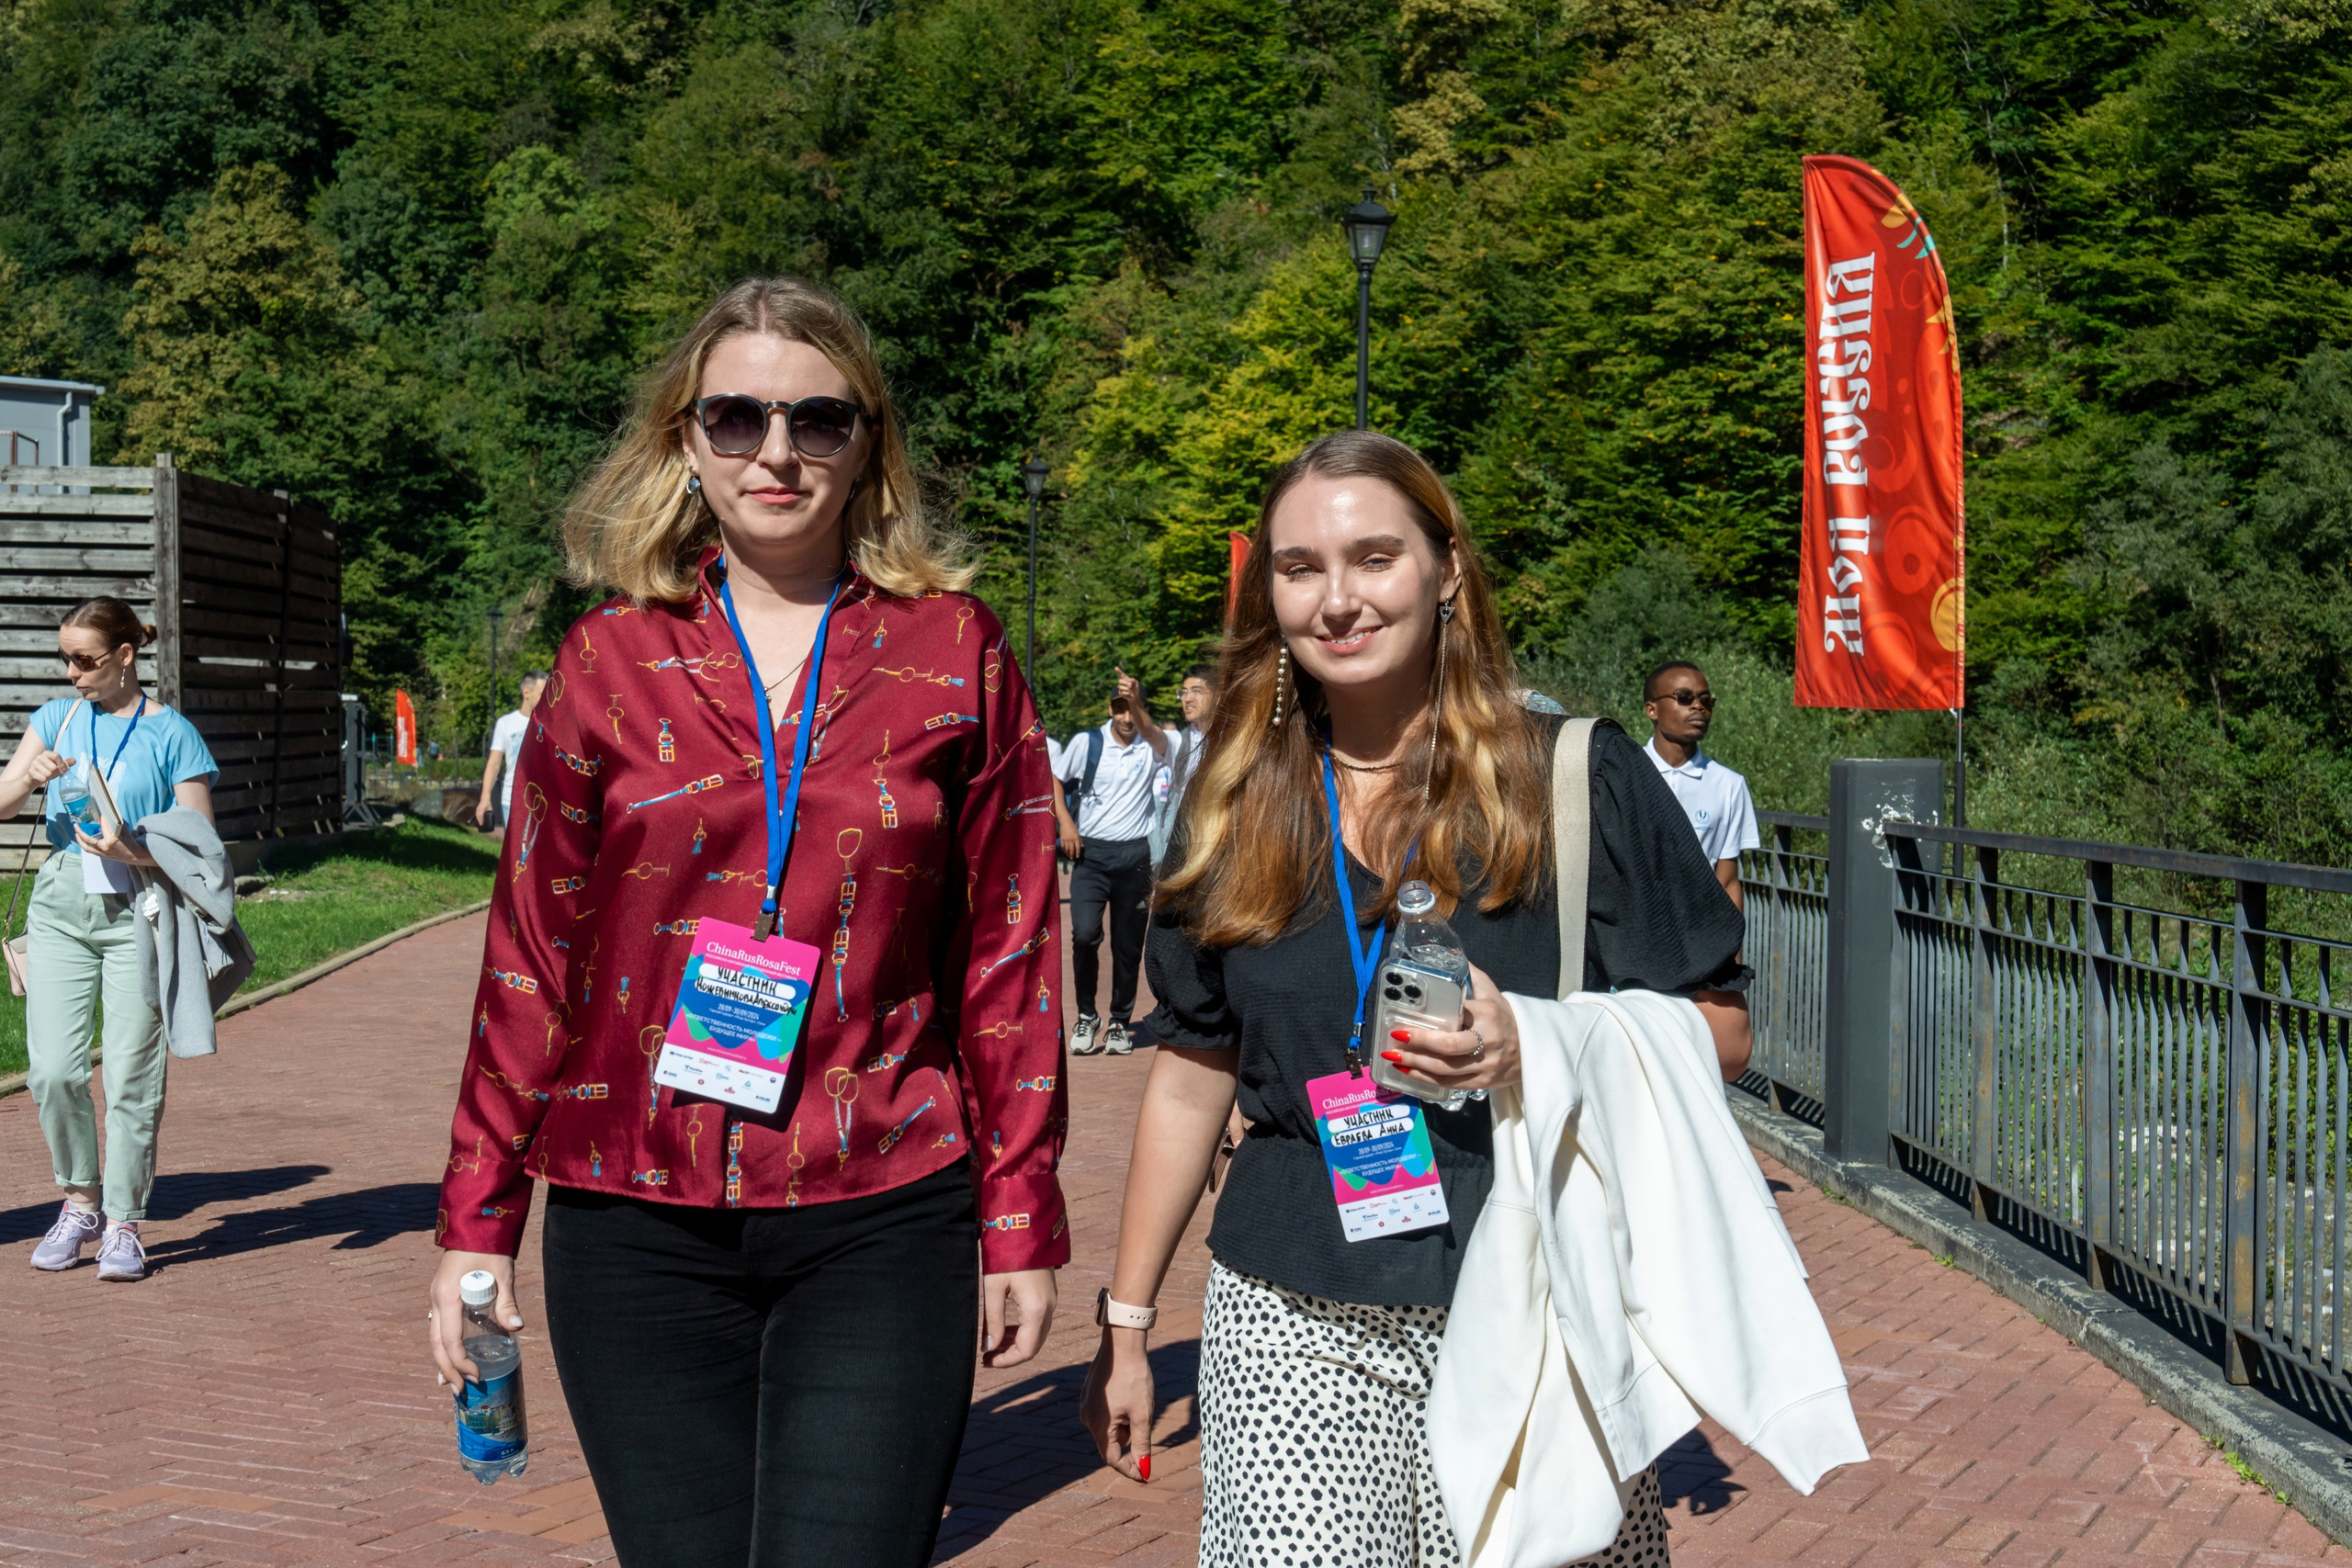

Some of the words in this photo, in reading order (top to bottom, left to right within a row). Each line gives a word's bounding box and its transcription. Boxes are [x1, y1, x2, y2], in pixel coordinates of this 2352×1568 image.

[706, 941, 801, 976] ChinaRusRosaFest
[716, 966, 778, 996] УЧАСТНИК
[708, 1025, 736, 1037] БУДУЩЕЕ
[1343, 1107, 1394, 1129] УЧАСТНИК
[1362, 1167, 1385, 1177] БУДУЩЕЕ
